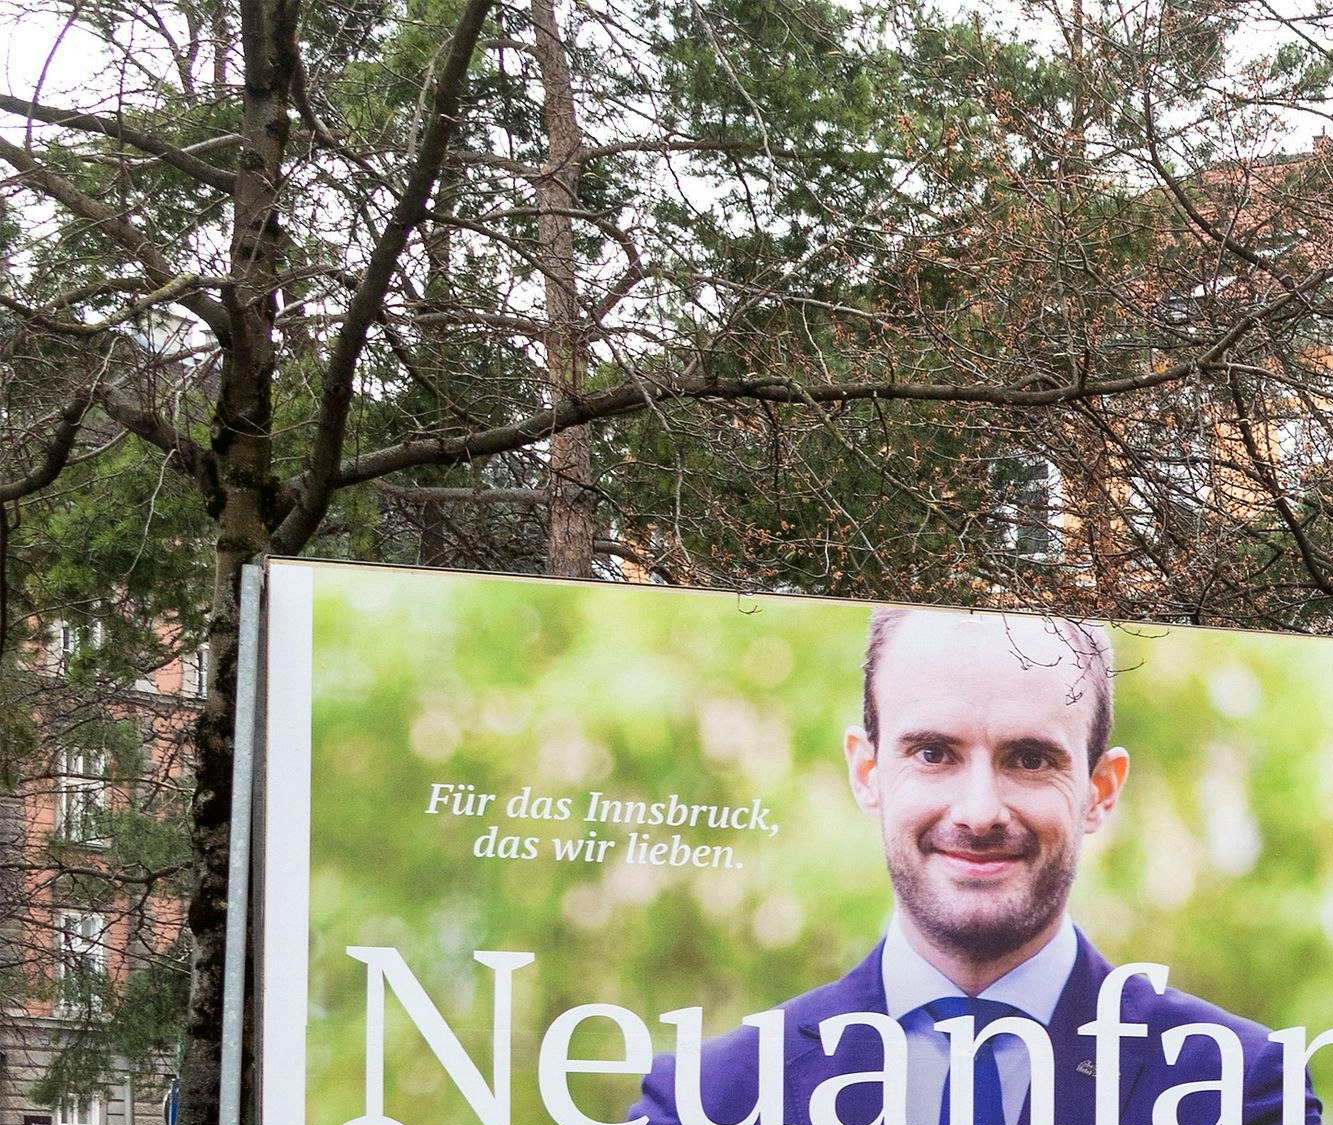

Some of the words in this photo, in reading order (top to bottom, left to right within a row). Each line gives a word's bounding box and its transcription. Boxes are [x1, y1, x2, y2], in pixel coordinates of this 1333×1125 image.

[424, 783, 495, 817] Für
[506, 787, 571, 820] das
[584, 791, 780, 837] Innsbruck,
[473, 827, 538, 860] das
[553, 831, 614, 863] wir
[626, 832, 744, 869] lieben.
